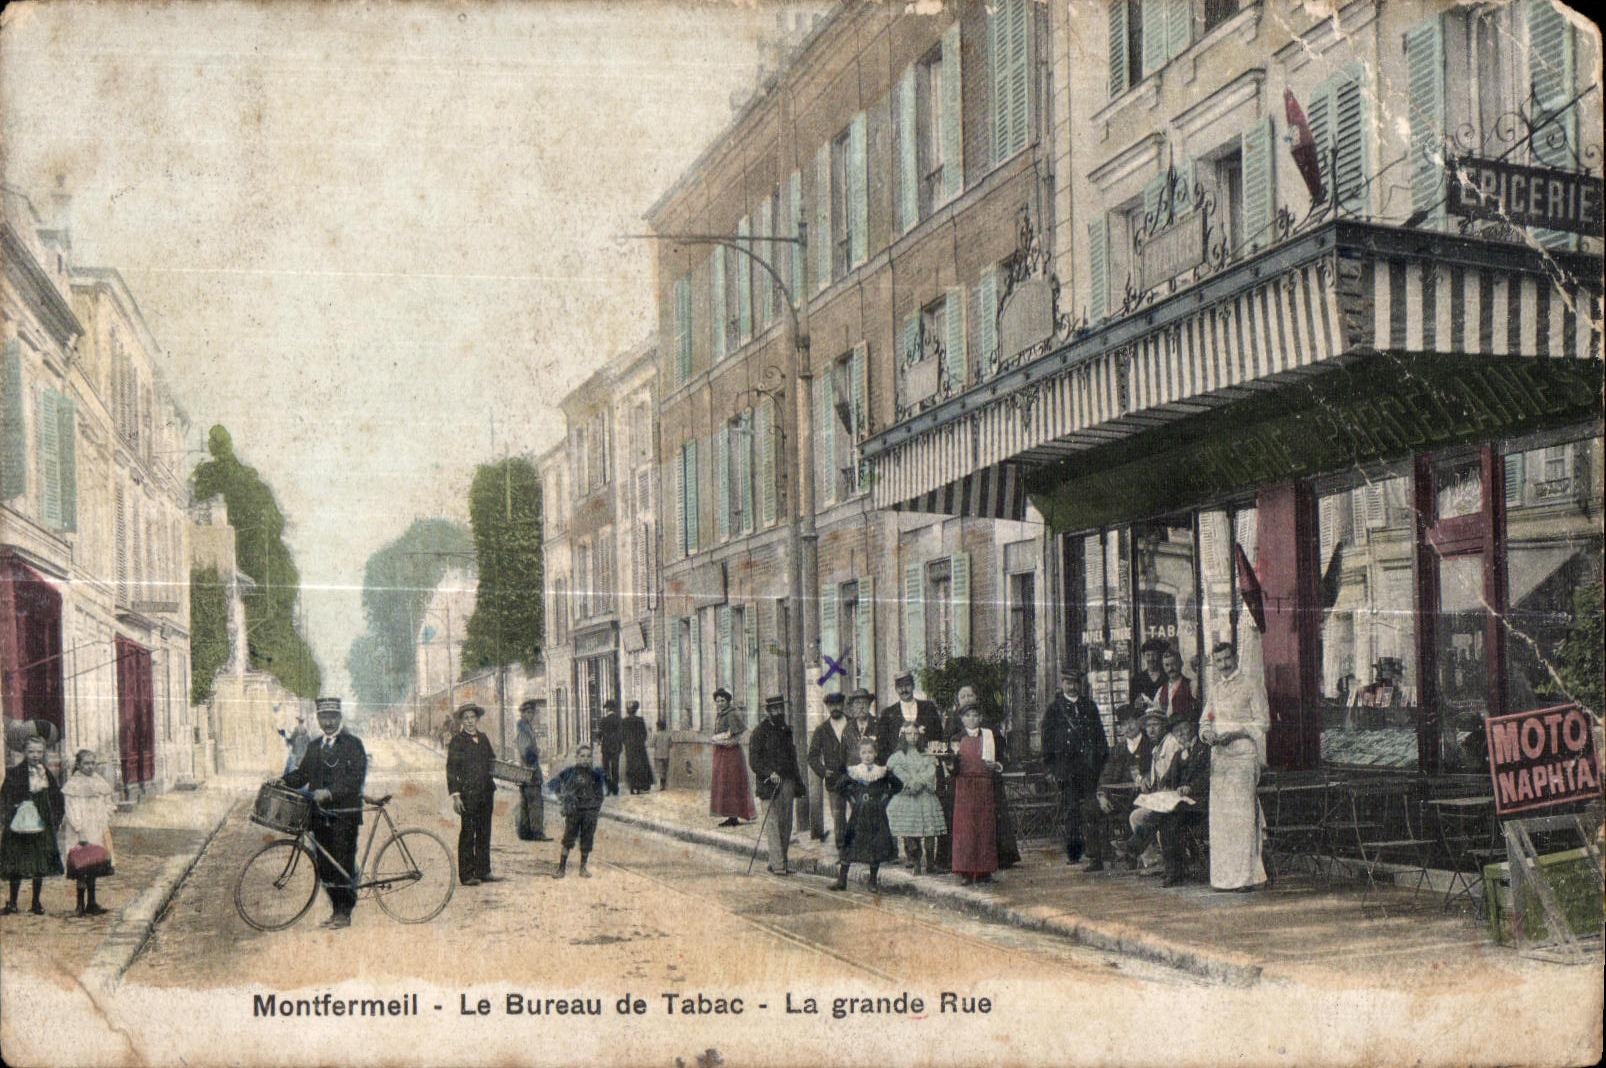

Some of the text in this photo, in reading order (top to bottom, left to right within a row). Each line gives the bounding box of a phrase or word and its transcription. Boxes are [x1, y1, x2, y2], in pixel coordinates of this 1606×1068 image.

[1459, 166, 1595, 223] EPICERIE
[1492, 709, 1588, 765] MOTO
[1498, 757, 1596, 804] NAPHTA
